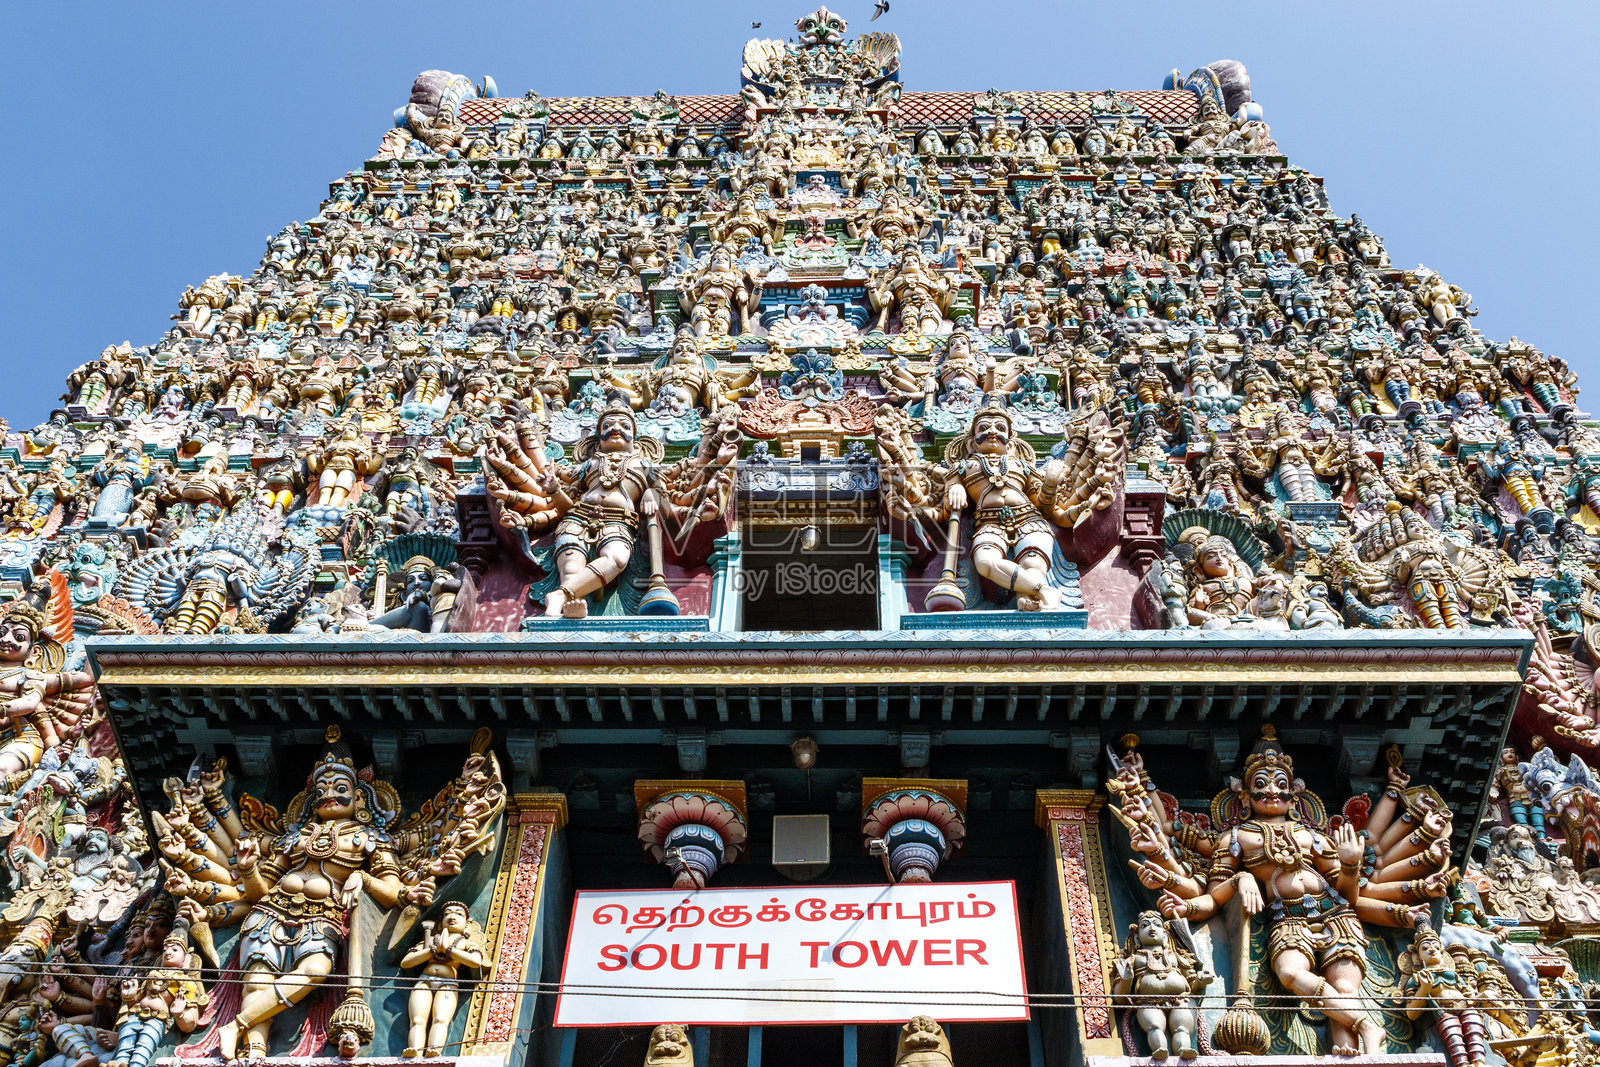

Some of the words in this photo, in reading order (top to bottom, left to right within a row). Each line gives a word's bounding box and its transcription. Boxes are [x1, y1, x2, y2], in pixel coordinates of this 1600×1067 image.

[592, 892, 997, 934] தெற்குக்கோபுரம்
[597, 942, 770, 972] SOUTH
[800, 938, 989, 969] TOWER
